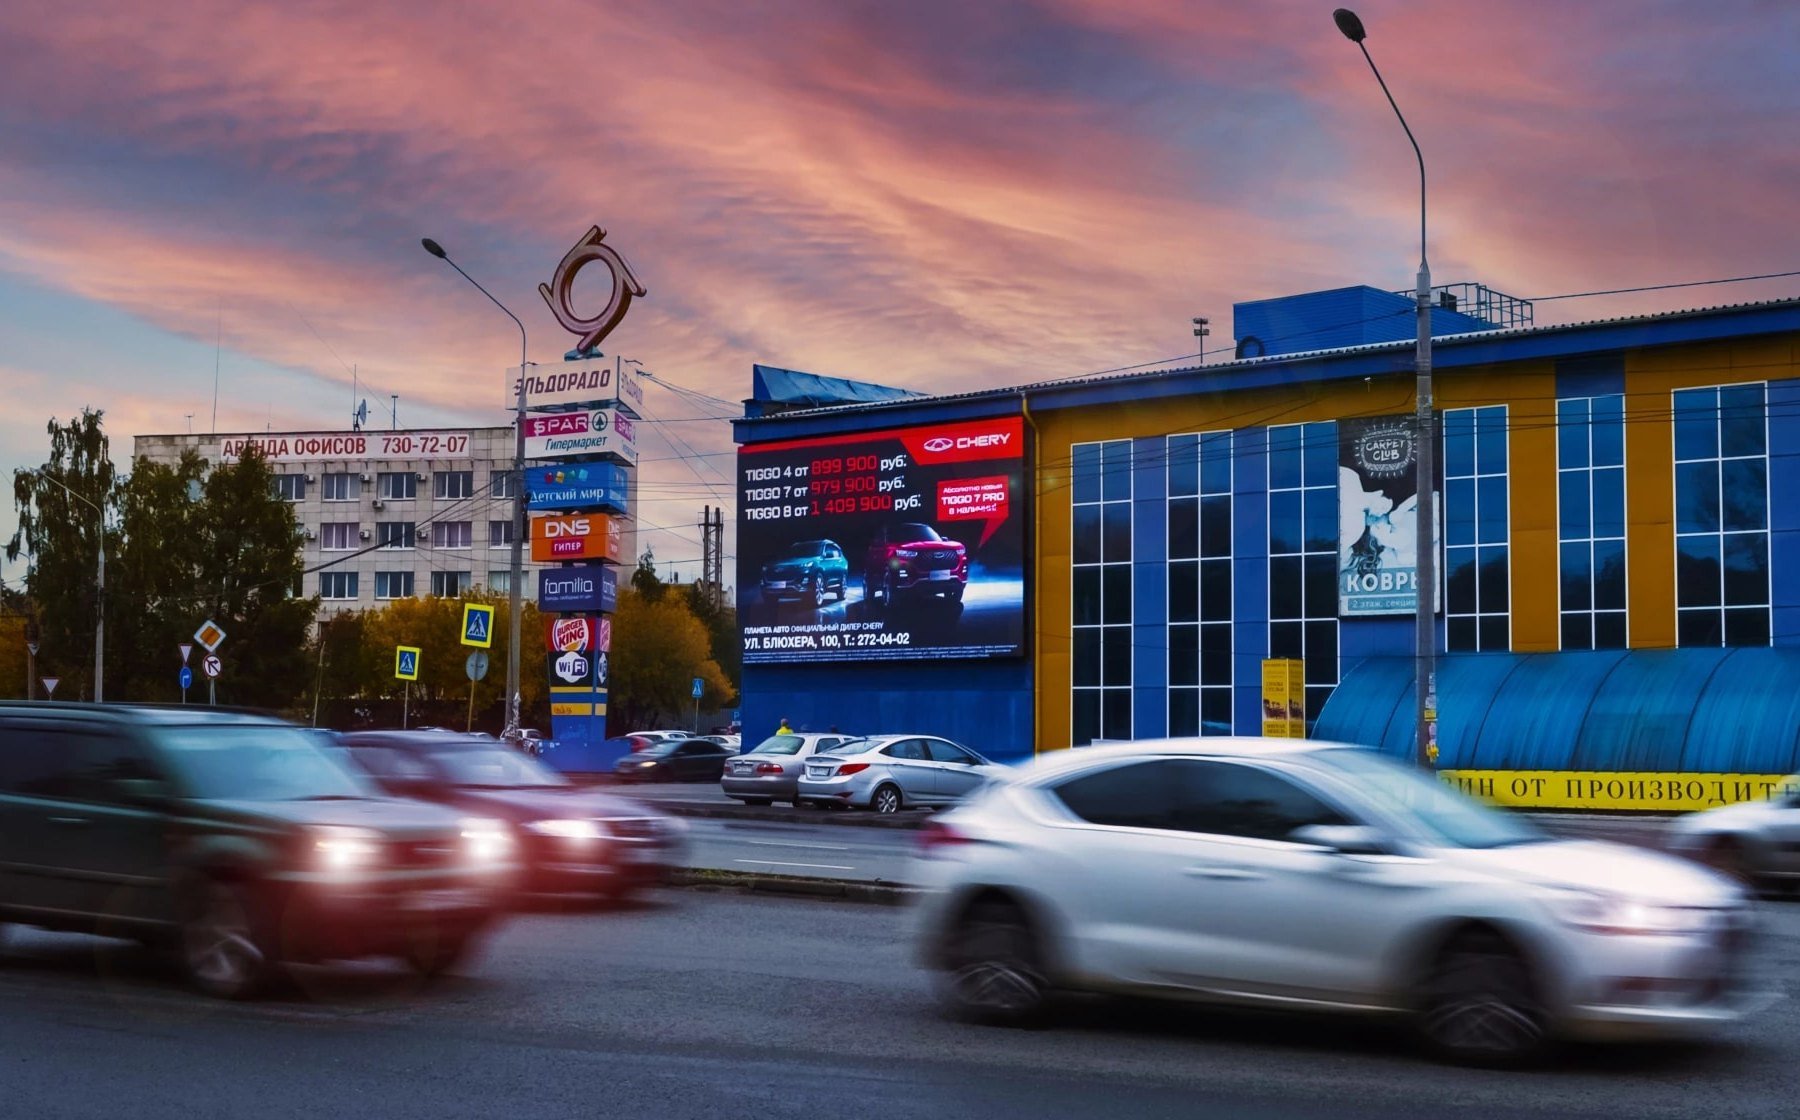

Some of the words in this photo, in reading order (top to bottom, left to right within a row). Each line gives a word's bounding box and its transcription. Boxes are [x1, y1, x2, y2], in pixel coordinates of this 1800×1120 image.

[533, 417, 588, 437] SPAR
[223, 439, 289, 458] АРНДА
[294, 437, 366, 455] ОФИСОВ
[382, 436, 467, 453] 730-72-07
[545, 437, 608, 451] Гипермаркет
[956, 433, 1011, 449] CHERY
[1365, 438, 1406, 451] CARPET
[1372, 449, 1400, 461] CLUB
[745, 467, 781, 481] TIGGO
[783, 466, 792, 478] 4
[811, 459, 842, 475] 899
[846, 455, 877, 472] 900
[530, 488, 576, 503] Детский
[579, 488, 604, 502] мир
[745, 487, 781, 501] TIGGO
[783, 486, 792, 498] 7
[811, 480, 840, 495] 979
[844, 476, 876, 493] 900
[941, 495, 972, 505] TIGGO
[974, 494, 981, 502] 7
[982, 492, 1004, 502] PRO
[745, 506, 781, 520] TIGGO
[783, 506, 792, 518] 8
[811, 501, 820, 516] 1
[824, 498, 856, 513] 409
[860, 495, 892, 511] 900
[545, 519, 591, 538] DNS
[554, 543, 582, 552] ГИПЕР
[545, 577, 593, 594] familia
[1352, 599, 1358, 608] 2
[557, 620, 583, 636] BURGER
[791, 623, 839, 633] ОФИЦИАЛЬНЫЙ
[840, 623, 861, 632] ДИЛЕР
[862, 622, 884, 630] CHERY
[559, 627, 585, 646] KING
[744, 637, 761, 649] УЛ.
[763, 635, 818, 649] БЛЮХЕРА,
[820, 635, 841, 648] 100,
[843, 634, 855, 646] Т.:
[857, 632, 910, 646] 272-04-02
[1511, 778, 1546, 798] ОТ
